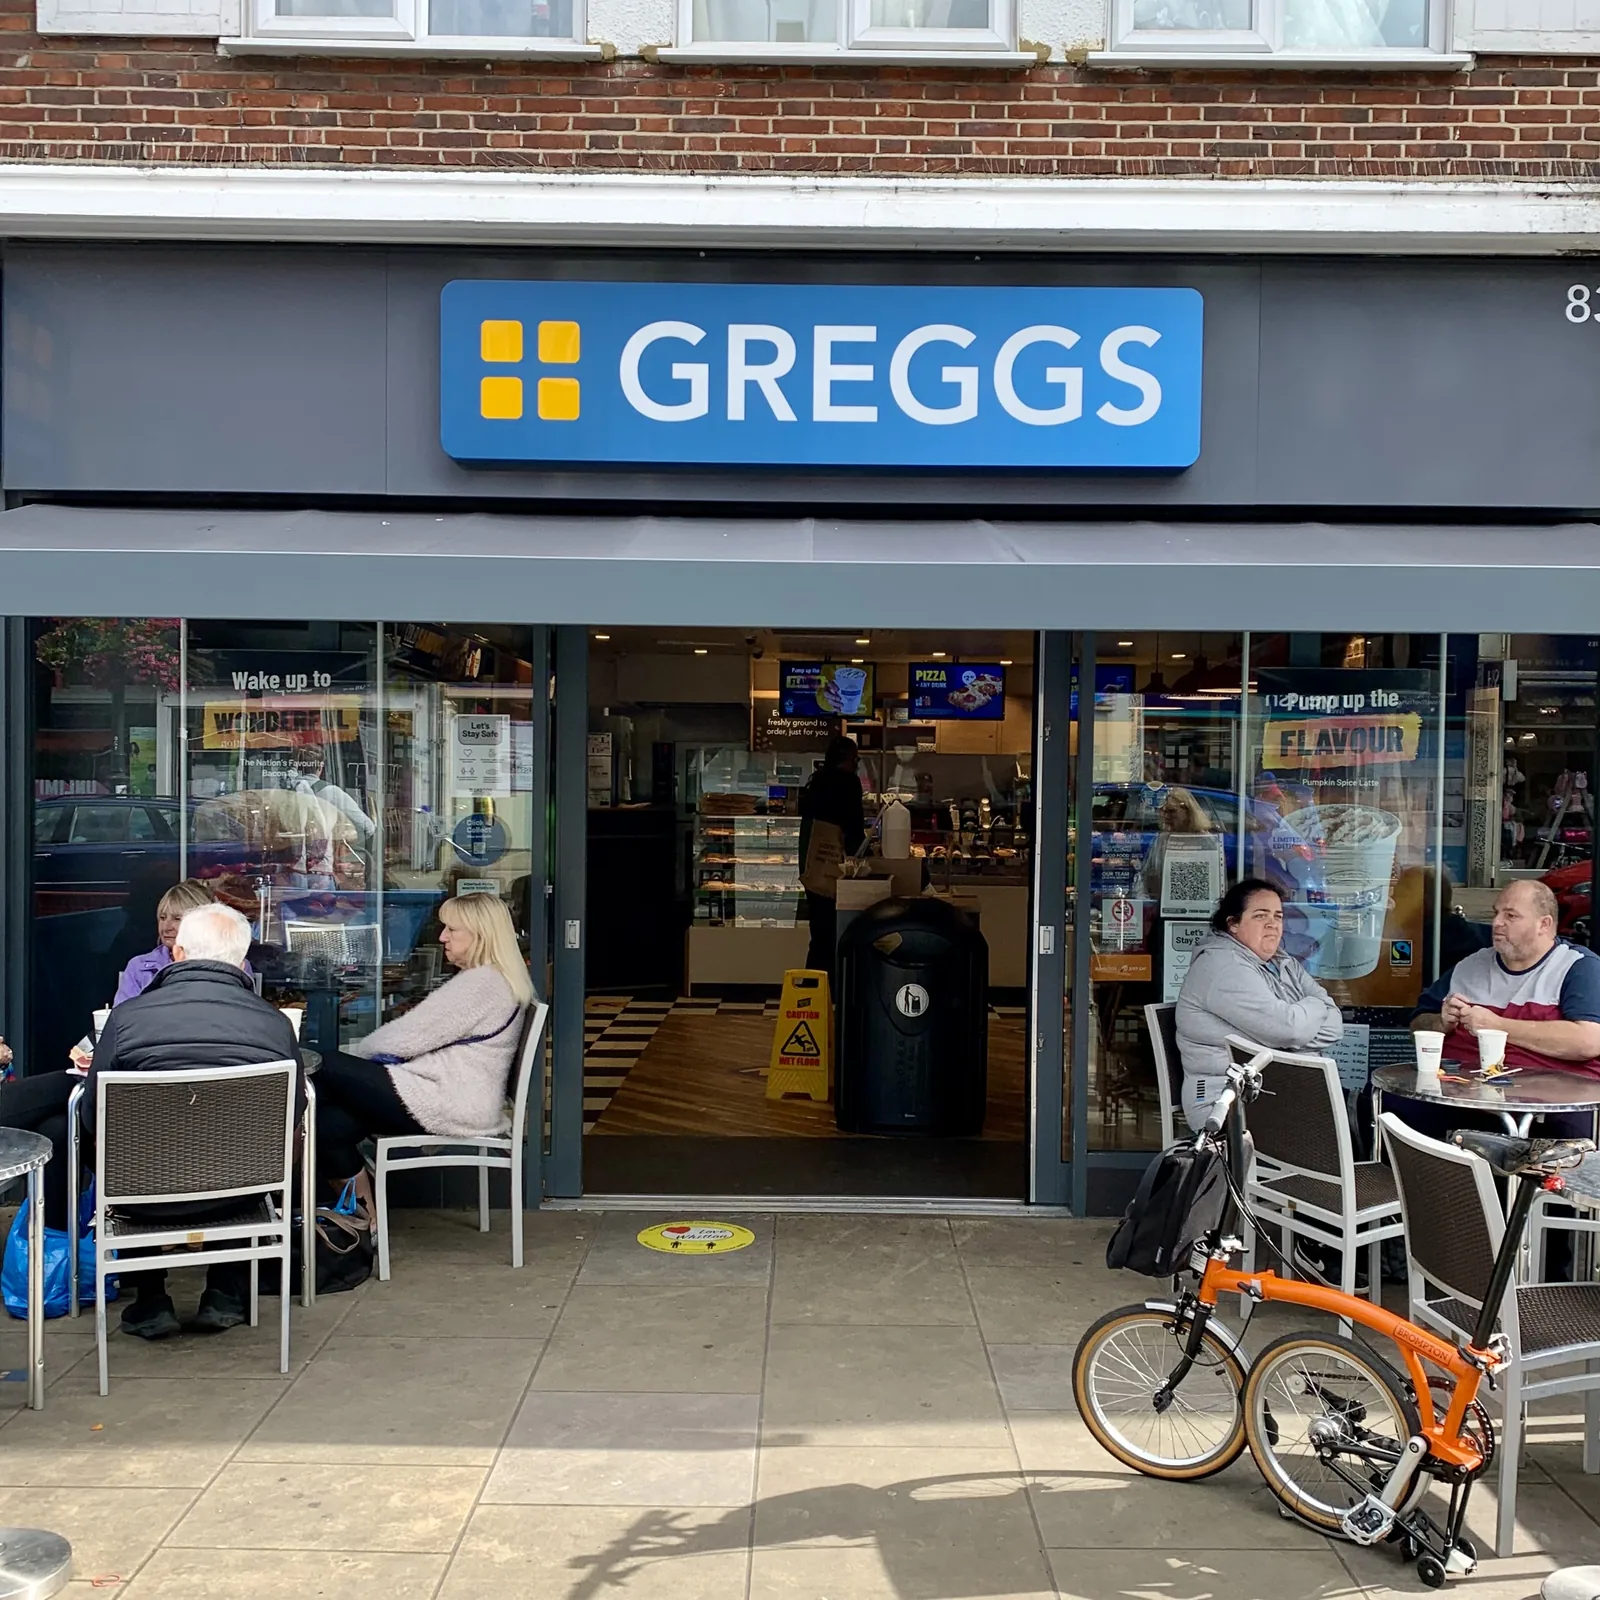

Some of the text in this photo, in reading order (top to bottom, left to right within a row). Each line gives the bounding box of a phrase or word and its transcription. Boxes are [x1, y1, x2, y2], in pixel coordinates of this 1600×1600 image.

[619, 320, 1163, 427] GREGGS
[915, 670, 947, 682] PIZZA
[231, 670, 332, 693] Wake up to
[1287, 692, 1340, 714] Pump
[1343, 693, 1364, 713] up
[1370, 688, 1400, 708] the
[470, 721, 490, 730] Let's
[767, 718, 828, 729] freshly ground to
[462, 730, 498, 739] Stay Safe
[766, 728, 788, 736] order,
[788, 728, 802, 737] just
[803, 728, 813, 736] for
[1280, 725, 1404, 758] FLAVOUR
[240, 758, 324, 768] The Nation's Favourite
[261, 770, 286, 778] Bacon
[1302, 778, 1379, 788] Pumpkin Spice Latte
[466, 819, 484, 827] Click
[1184, 928, 1204, 937] Let's
[1175, 936, 1194, 946] Stay
[786, 1011, 819, 1019] CAUTION
[779, 1057, 820, 1066] WET FLOOR
[1397, 1327, 1449, 1360] BROMPTON
